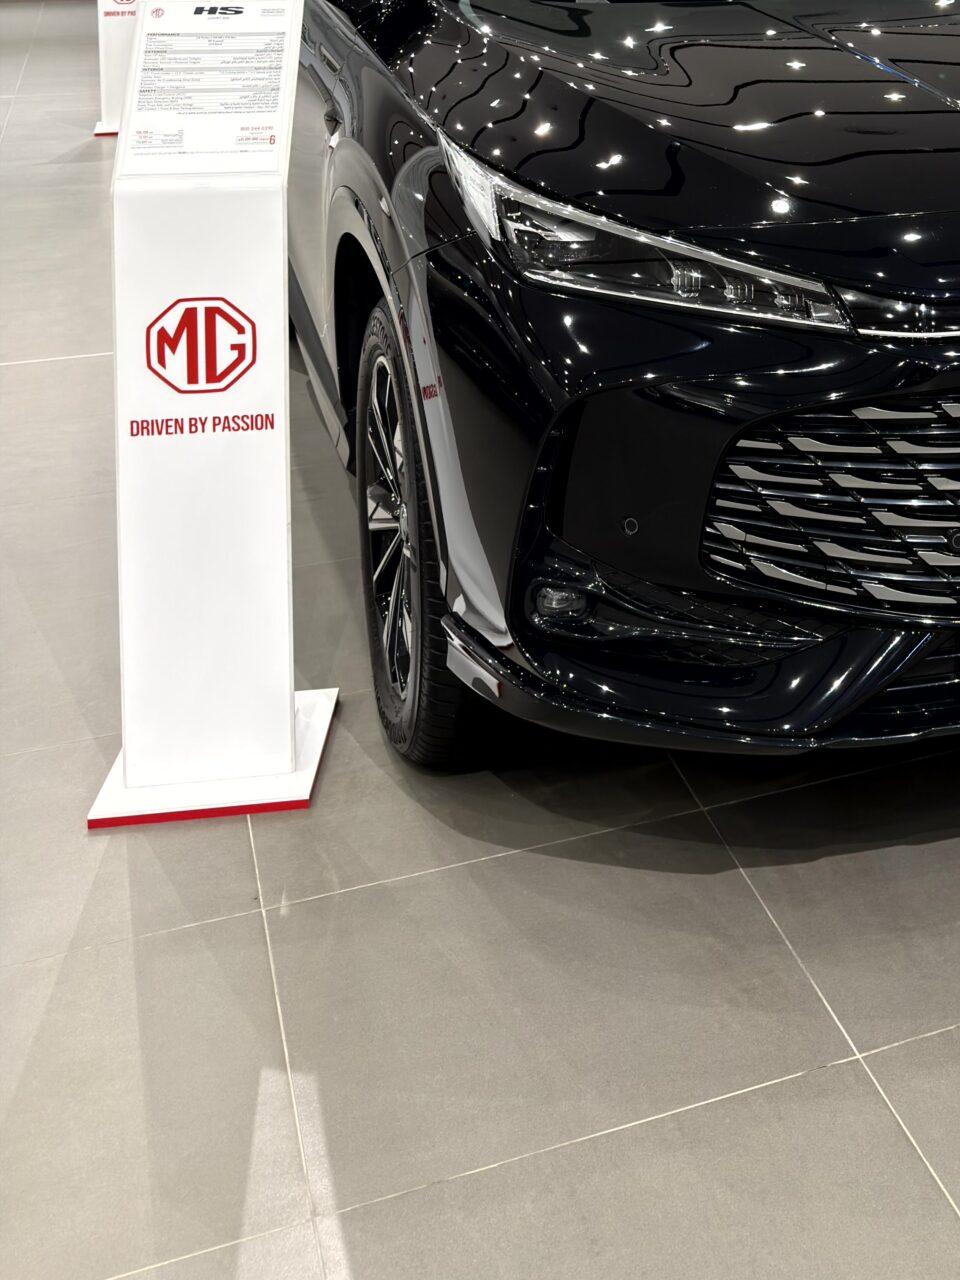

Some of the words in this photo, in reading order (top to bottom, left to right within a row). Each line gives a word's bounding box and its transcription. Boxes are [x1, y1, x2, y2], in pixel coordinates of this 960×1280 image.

[193, 6, 244, 15] HS
[269, 134, 276, 145] 6
[156, 306, 246, 385] MG
[130, 418, 184, 437] DRIVEN
[188, 417, 208, 434] BY
[212, 414, 275, 432] PASSION
